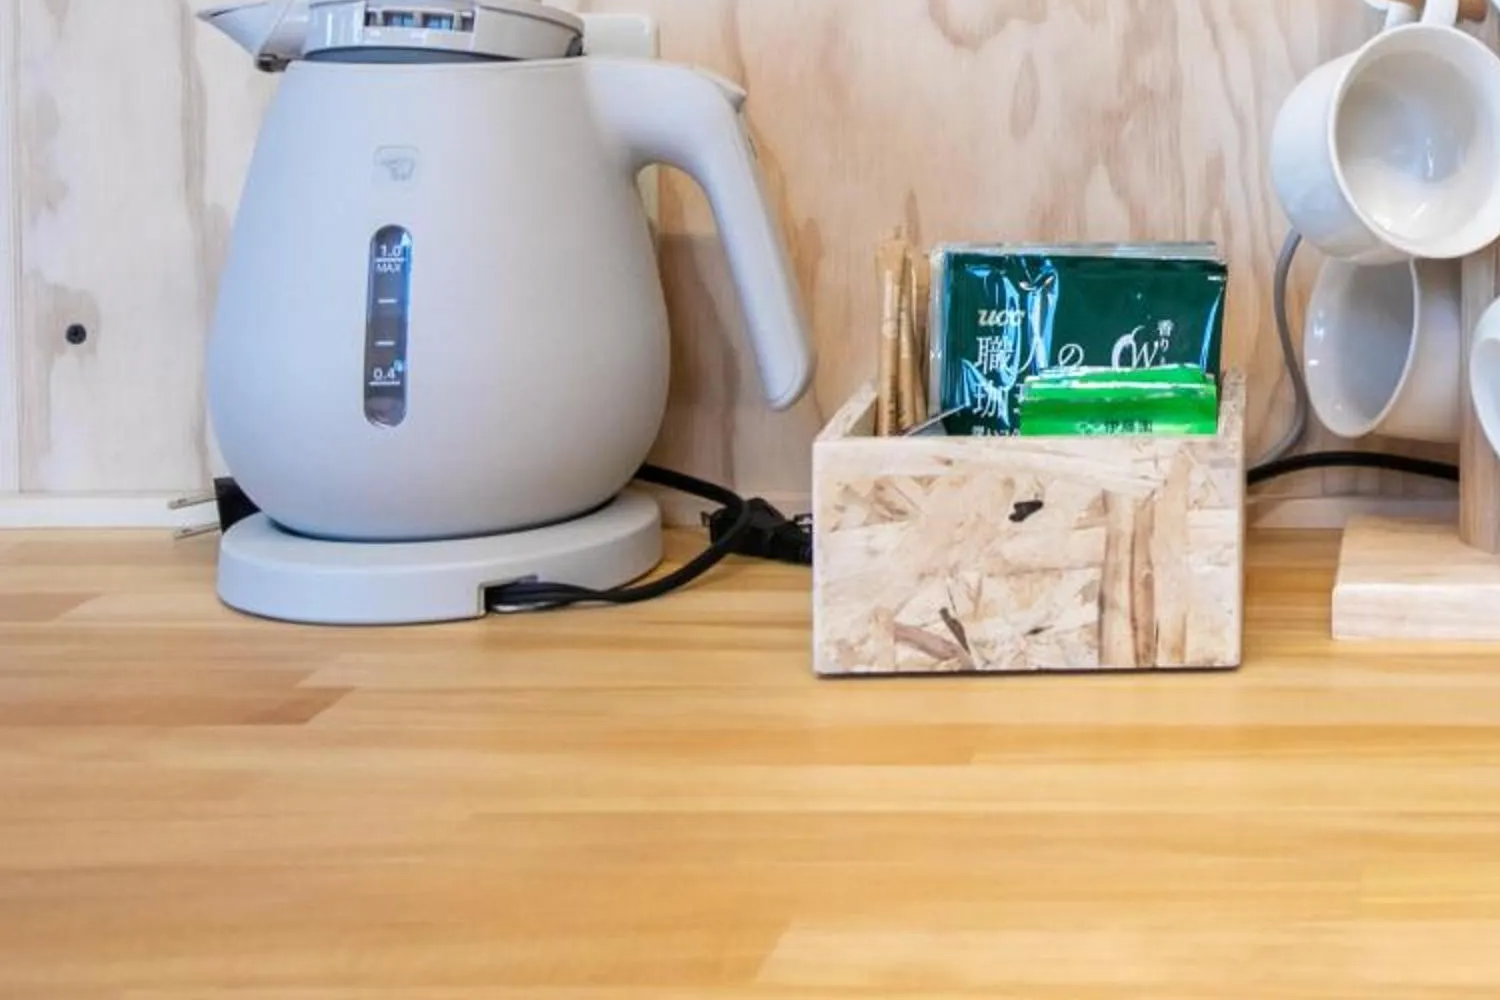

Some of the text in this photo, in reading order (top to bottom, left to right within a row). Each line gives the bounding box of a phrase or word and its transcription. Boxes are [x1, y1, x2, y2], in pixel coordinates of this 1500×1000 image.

[380, 245, 401, 257] 1.0
[377, 263, 401, 273] MAX
[373, 367, 396, 379] 0.4
